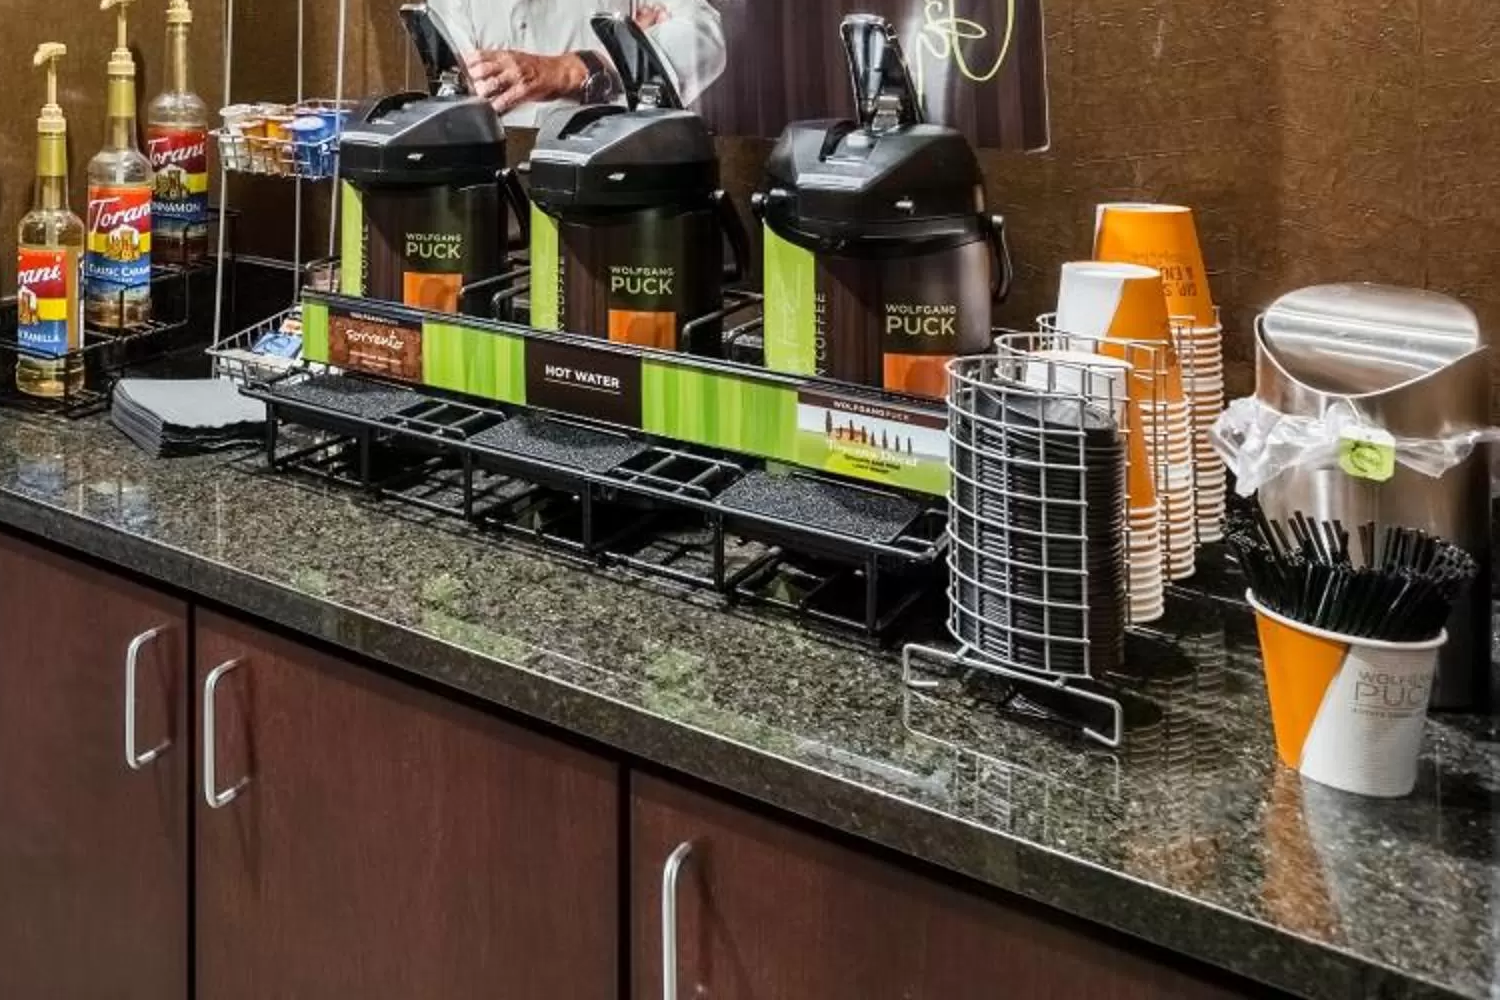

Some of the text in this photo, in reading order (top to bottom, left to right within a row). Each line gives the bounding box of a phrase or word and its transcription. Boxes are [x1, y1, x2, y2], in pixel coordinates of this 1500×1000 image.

[88, 196, 151, 233] Toran
[405, 232, 462, 243] WOLFGANG
[405, 242, 462, 260] PUCK
[17, 255, 63, 286] rani
[610, 266, 675, 277] WOLFGANG
[610, 276, 674, 296] PUCK
[885, 303, 957, 316] WOLFGANG
[885, 315, 956, 336] PUCK
[544, 364, 621, 389] HOT WATER
[1355, 681, 1426, 707] PUC
